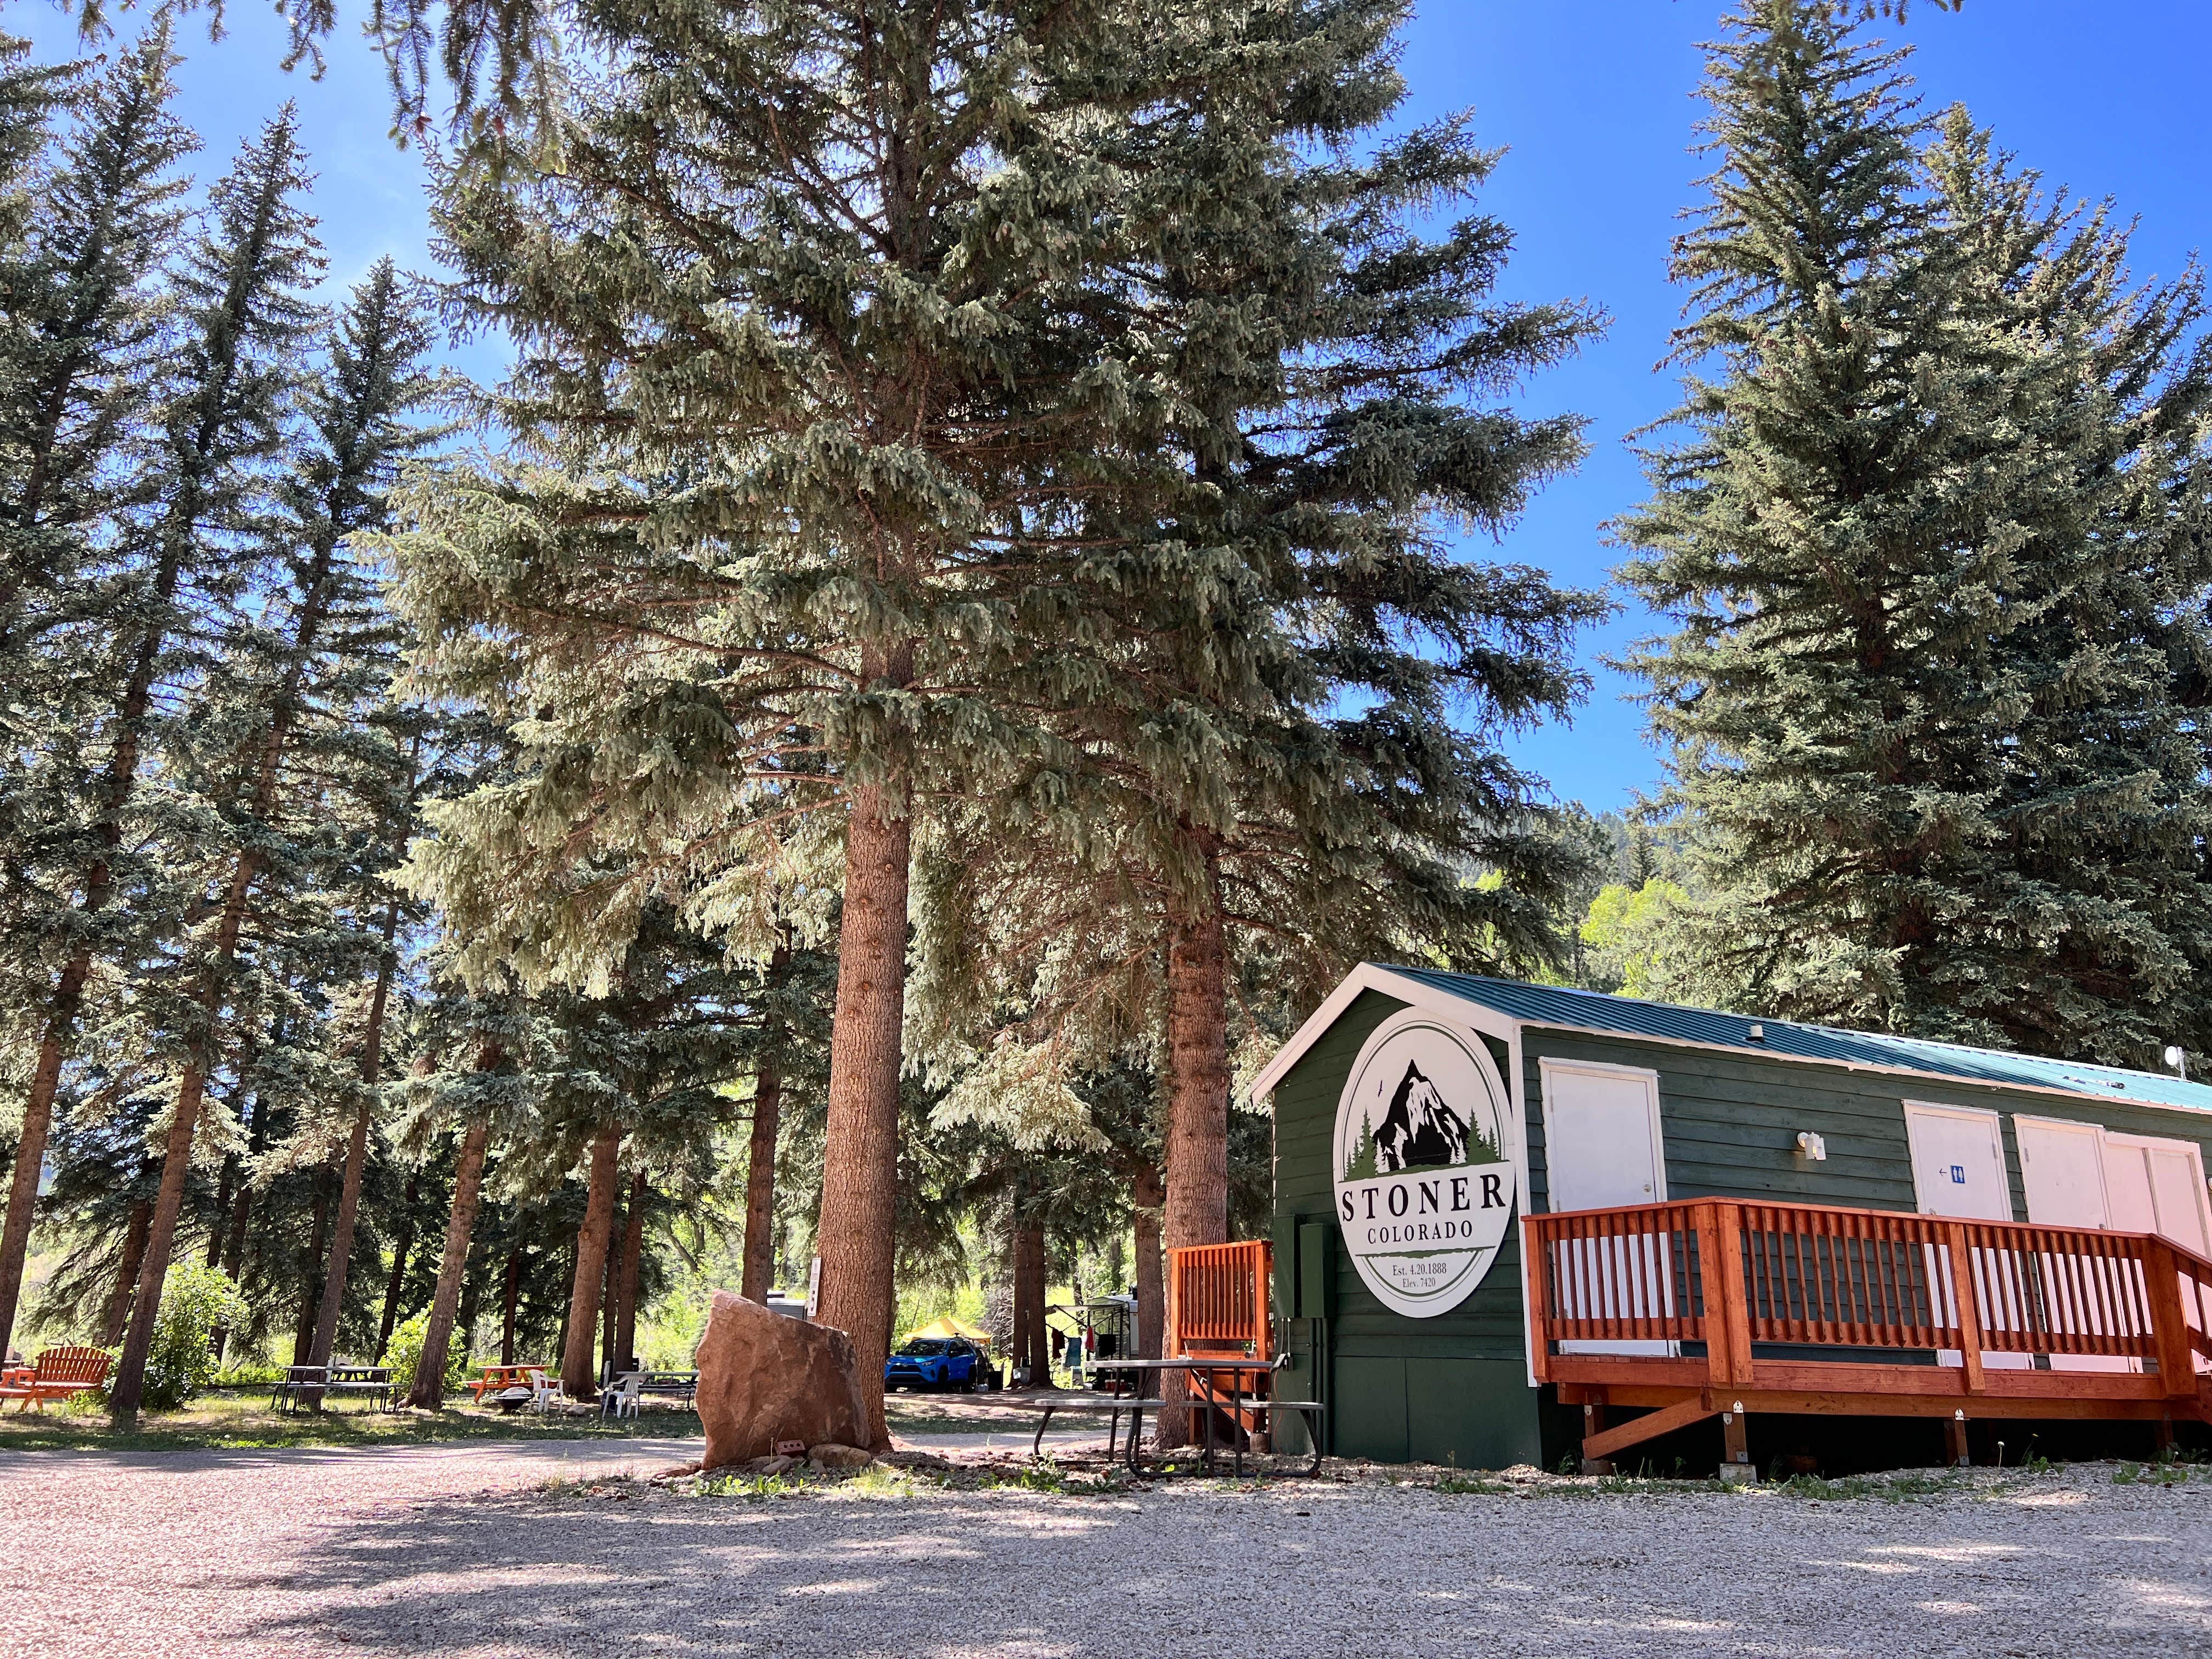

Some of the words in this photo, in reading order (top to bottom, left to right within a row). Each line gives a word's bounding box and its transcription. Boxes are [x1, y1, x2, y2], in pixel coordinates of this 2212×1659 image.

[1342, 1173, 1506, 1222] STONER
[1368, 1220, 1472, 1244] COLORADO
[1392, 1265, 1408, 1276] Est.
[1409, 1262, 1447, 1275] 4.20.1888
[1402, 1278, 1419, 1288] Elev.
[1420, 1277, 1436, 1287] 7420
